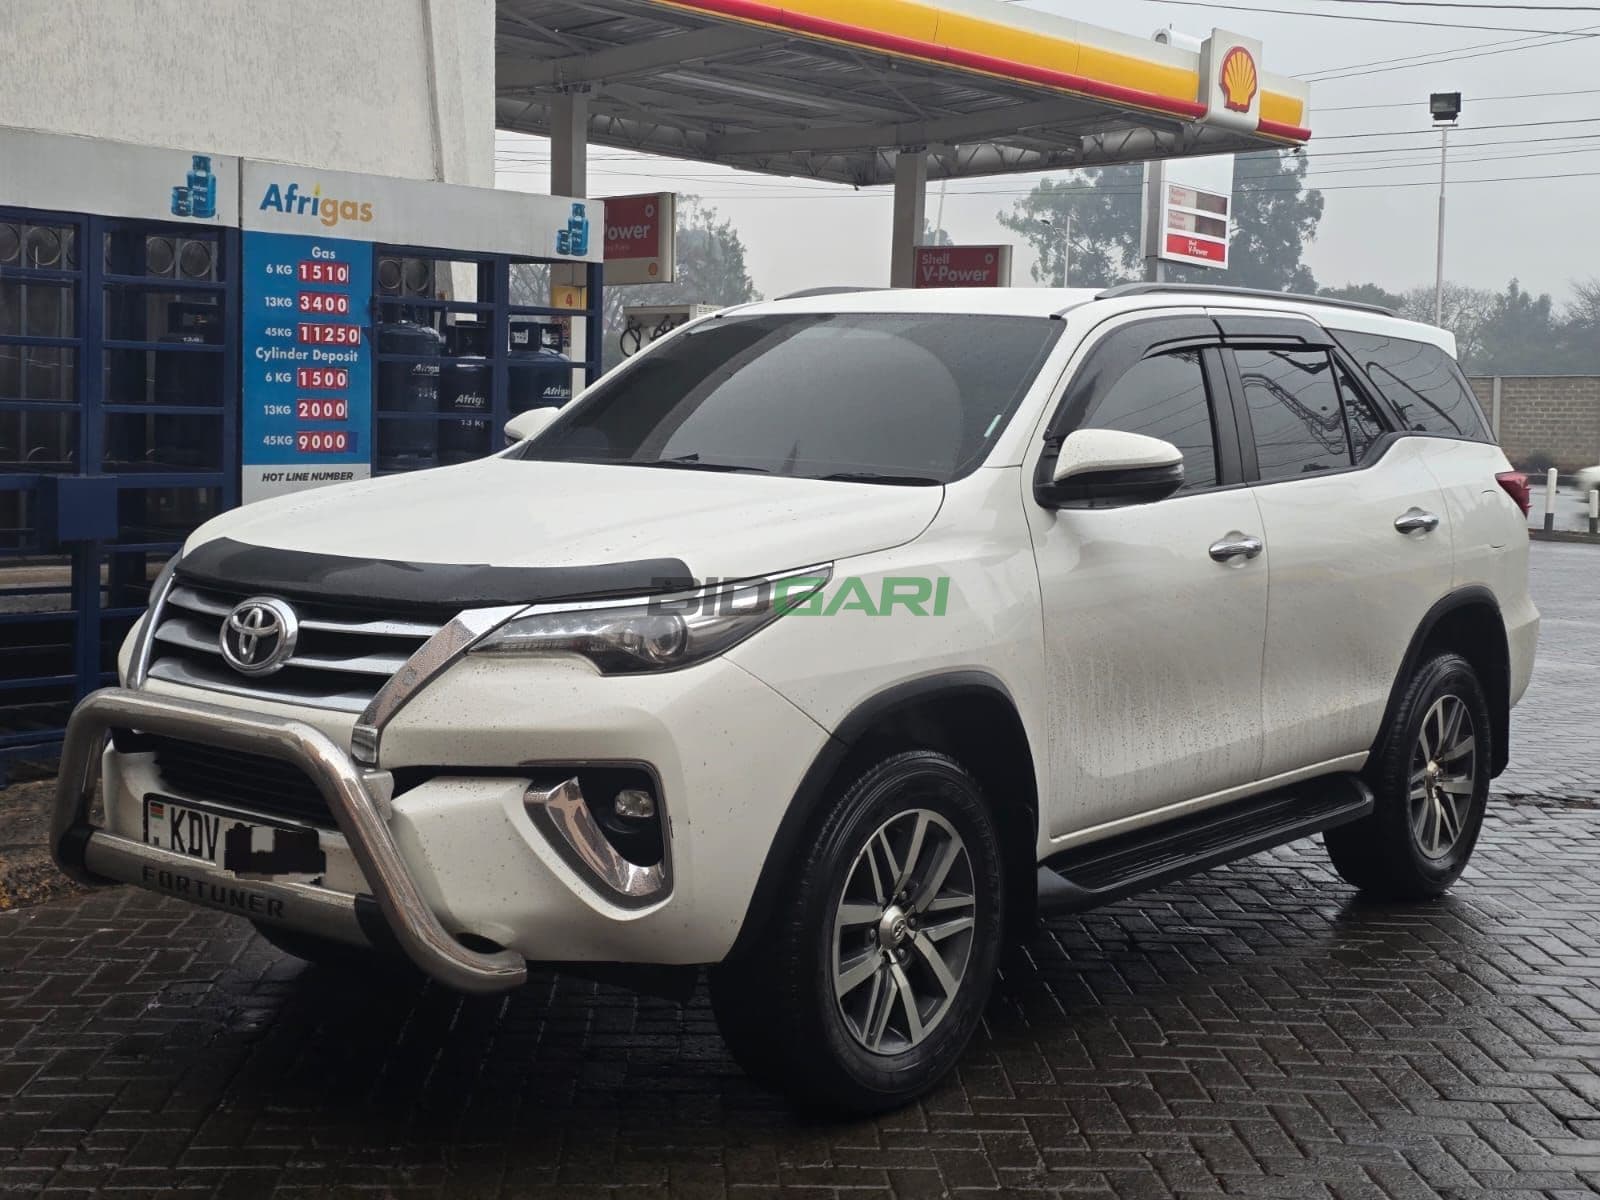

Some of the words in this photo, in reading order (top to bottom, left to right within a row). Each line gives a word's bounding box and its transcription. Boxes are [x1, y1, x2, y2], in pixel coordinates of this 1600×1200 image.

[260, 182, 373, 227] Afrigas
[604, 224, 650, 241] ower
[312, 246, 336, 259] Gas
[921, 253, 950, 265] Shell
[266, 264, 273, 274] 6
[276, 265, 293, 275] KG
[300, 264, 347, 282] 1510
[921, 266, 990, 281] V-Power
[264, 296, 293, 308] 13KG
[300, 295, 347, 312] 3400
[264, 327, 292, 337] 45KG
[301, 326, 358, 343] 11250
[255, 347, 309, 362] Cylinder
[312, 349, 358, 364] Deposit
[265, 373, 272, 383] 6
[275, 372, 292, 383] KG
[300, 371, 346, 386] 1500
[263, 404, 291, 415] 13KG
[299, 402, 345, 417] 2000
[263, 435, 293, 446] 45KG
[299, 434, 345, 449] 9000
[262, 472, 284, 482] HOT
[285, 472, 309, 482] LINE
[310, 471, 354, 481] NUMBER
[170, 806, 220, 860] KDV
[141, 865, 284, 918] FORTUNER
